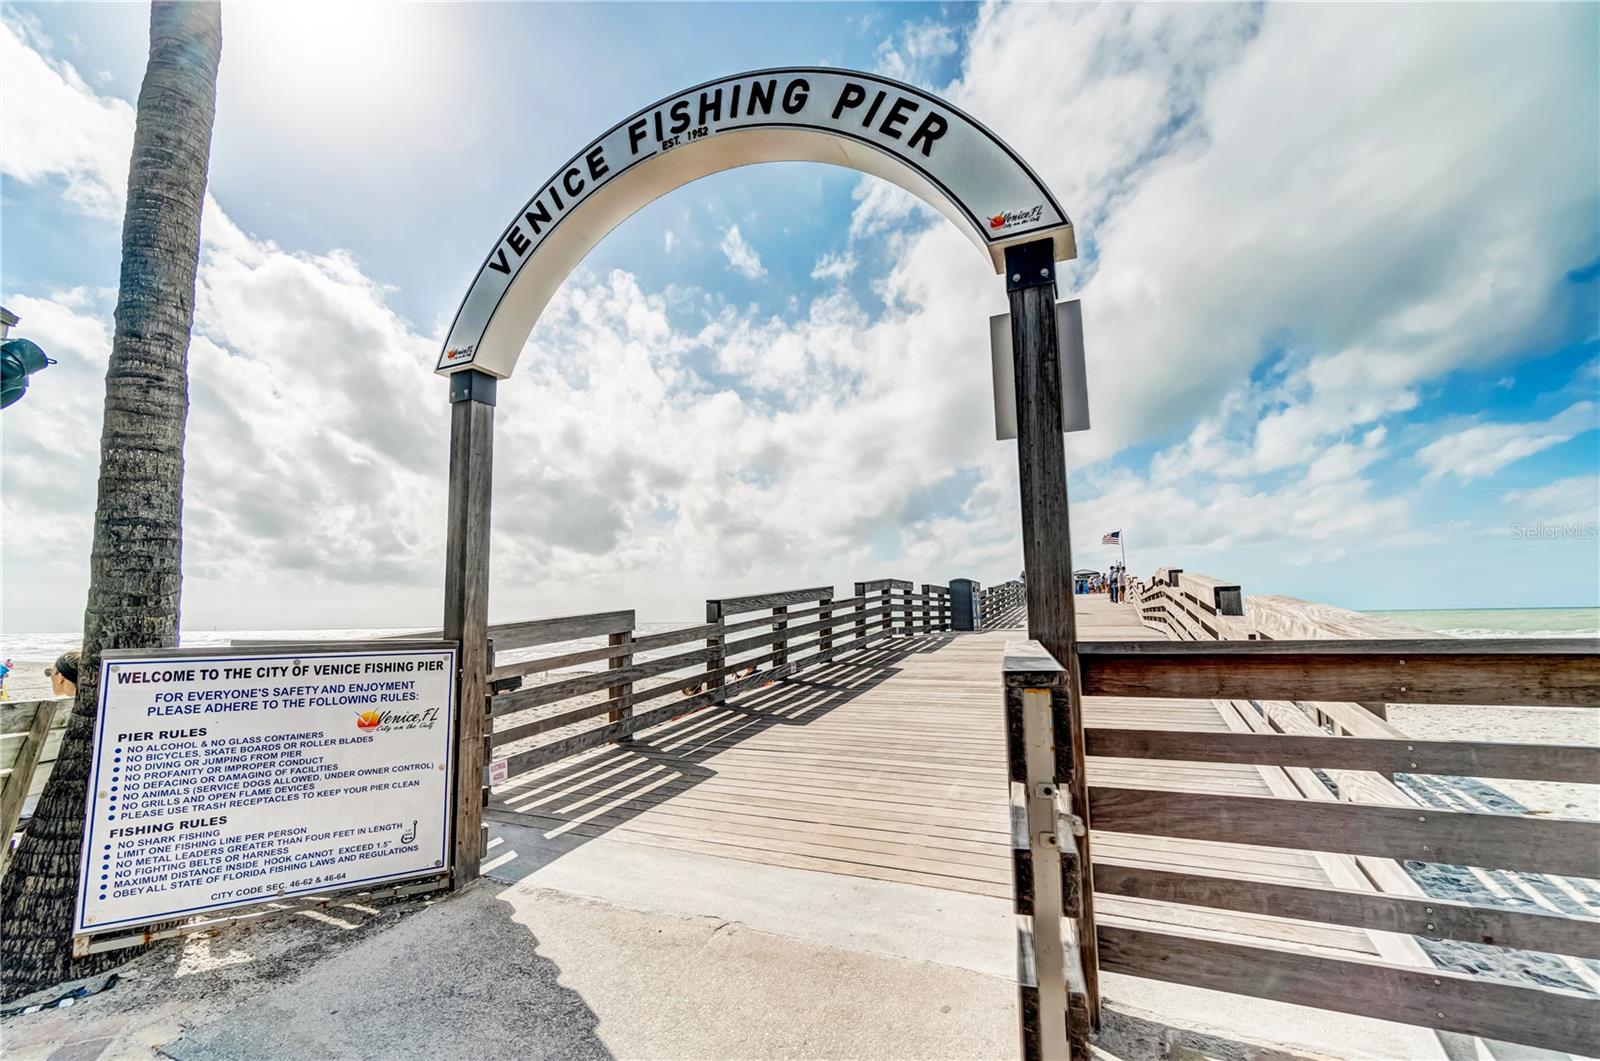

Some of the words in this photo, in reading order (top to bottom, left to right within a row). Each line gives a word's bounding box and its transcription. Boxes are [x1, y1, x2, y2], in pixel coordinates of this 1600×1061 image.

[662, 135, 681, 151] EST.
[687, 126, 709, 141] 1952
[489, 146, 610, 275] VENICE
[629, 79, 810, 155] FISHING
[832, 83, 949, 158] PIER
[117, 669, 195, 684] WELCOME
[199, 668, 219, 681] TO
[223, 667, 252, 680] THE
[256, 666, 289, 678] CITY
[292, 665, 310, 677] OF
[313, 663, 361, 676] VENICE
[364, 661, 414, 674] FISHING
[417, 660, 444, 672] PIER
[147, 704, 201, 717] PLEASE
[204, 701, 258, 713] ADHERE
[262, 700, 279, 710] TO
[282, 698, 306, 709] THE
[309, 694, 377, 707] FOLLOWING
[380, 691, 419, 702] RULES:
[155, 692, 184, 703] FOR
[187, 688, 269, 701] EVERYONE'S
[273, 685, 320, 697] SAFETY
[320, 684, 346, 694] AND
[348, 680, 416, 693] ENJOYMENT
[118, 731, 154, 743] PIER
[159, 727, 207, 740] RULES
[376, 725, 392, 733] City
[419, 722, 435, 730] Gulf
[126, 754, 143, 763] NO
[204, 747, 237, 756] SKATE
[240, 743, 281, 753] BOARDS
[283, 742, 297, 750] OR
[300, 739, 337, 748] ROLLER
[338, 735, 374, 745] BLADES
[127, 745, 144, 753] NO
[146, 741, 198, 752] ALCOHOL
[200, 740, 208, 748] &
[211, 739, 226, 747] NO
[228, 736, 262, 745] GLASS
[264, 731, 324, 743] CONTAINERS
[124, 773, 141, 782] NO
[144, 767, 204, 780] PROFANITY
[206, 766, 221, 774] OR
[224, 761, 276, 772] IMPROPER
[278, 756, 324, 767] CONDUCT
[125, 764, 142, 772] NO
[145, 760, 181, 771] DIVING
[184, 759, 200, 767] OR
[202, 755, 247, 766] JUMPING
[250, 752, 278, 761] FROM
[280, 750, 302, 758] PIER
[122, 792, 139, 801] NO
[141, 787, 190, 799] ANIMALS
[193, 782, 239, 794] (SERVICE
[243, 779, 271, 788] DOGS
[324, 770, 356, 780] UNDER
[357, 767, 390, 776] OWNER
[391, 762, 434, 773] CONTROL)
[123, 783, 140, 791] NO
[143, 777, 197, 790] DEFACING
[200, 775, 215, 784] OR
[218, 770, 272, 782] DAMAGING
[274, 768, 287, 776] OF
[290, 763, 338, 775] FACILITIES
[120, 808, 164, 820] PLEASE
[167, 805, 189, 815] USE
[192, 801, 227, 812] TRASH
[229, 793, 300, 808] RECEPTACLES
[302, 791, 315, 799] TO
[317, 788, 341, 798] KEEP
[343, 785, 368, 794] YOUR
[370, 783, 390, 791] PIER
[391, 779, 420, 789] CLEAN
[121, 802, 138, 811] NO
[141, 797, 180, 808] GRILLS
[182, 794, 205, 804] AND
[208, 792, 236, 801] OPEN
[239, 787, 272, 797] FLAME
[275, 783, 315, 794] DEVICES
[109, 822, 174, 839] FISHING
[179, 815, 228, 830] RULES
[117, 840, 134, 849] NO
[137, 835, 175, 847] SHARK
[179, 829, 220, 841] FISHING
[116, 860, 133, 869] NO
[135, 855, 172, 866] METAL
[175, 847, 224, 861] LEADERS
[227, 840, 274, 853] GREATER
[277, 836, 303, 846] THAN
[305, 832, 331, 842] FOUR
[333, 829, 355, 838] FEET
[357, 827, 366, 835] IN
[368, 822, 403, 834] LENGTH
[117, 848, 146, 859] LIMIT
[148, 845, 171, 855] ONE
[175, 839, 216, 851] FISHING
[219, 835, 242, 845] LINE
[245, 832, 265, 842] PER
[267, 827, 307, 838] PERSON
[113, 886, 145, 898] OBEY
[146, 884, 167, 893] ALL
[170, 877, 203, 890] STATE
[206, 875, 220, 884] OF
[222, 868, 267, 881] FLORIDA
[269, 861, 307, 874] FISHING
[310, 857, 336, 868] LAWS
[337, 854, 357, 863] AND
[358, 844, 419, 860] REGULATIONS
[114, 874, 168, 888] MAXIMUM
[171, 865, 222, 880] DISTANCE
[226, 860, 258, 872] INSIDE
[264, 855, 292, 866] HOOK
[294, 849, 334, 861] CANNOT
[338, 843, 374, 855] EXCEED
[115, 869, 132, 879] NO
[135, 861, 186, 876] FIGHTING
[189, 856, 222, 868] BELTS
[224, 854, 239, 863] OR
[242, 847, 289, 860] HARNESS
[210, 890, 234, 901] CITY
[236, 885, 263, 896] CODE
[266, 882, 287, 892] SEC.
[289, 878, 313, 887] 46-62
[324, 872, 346, 881] 46-64
